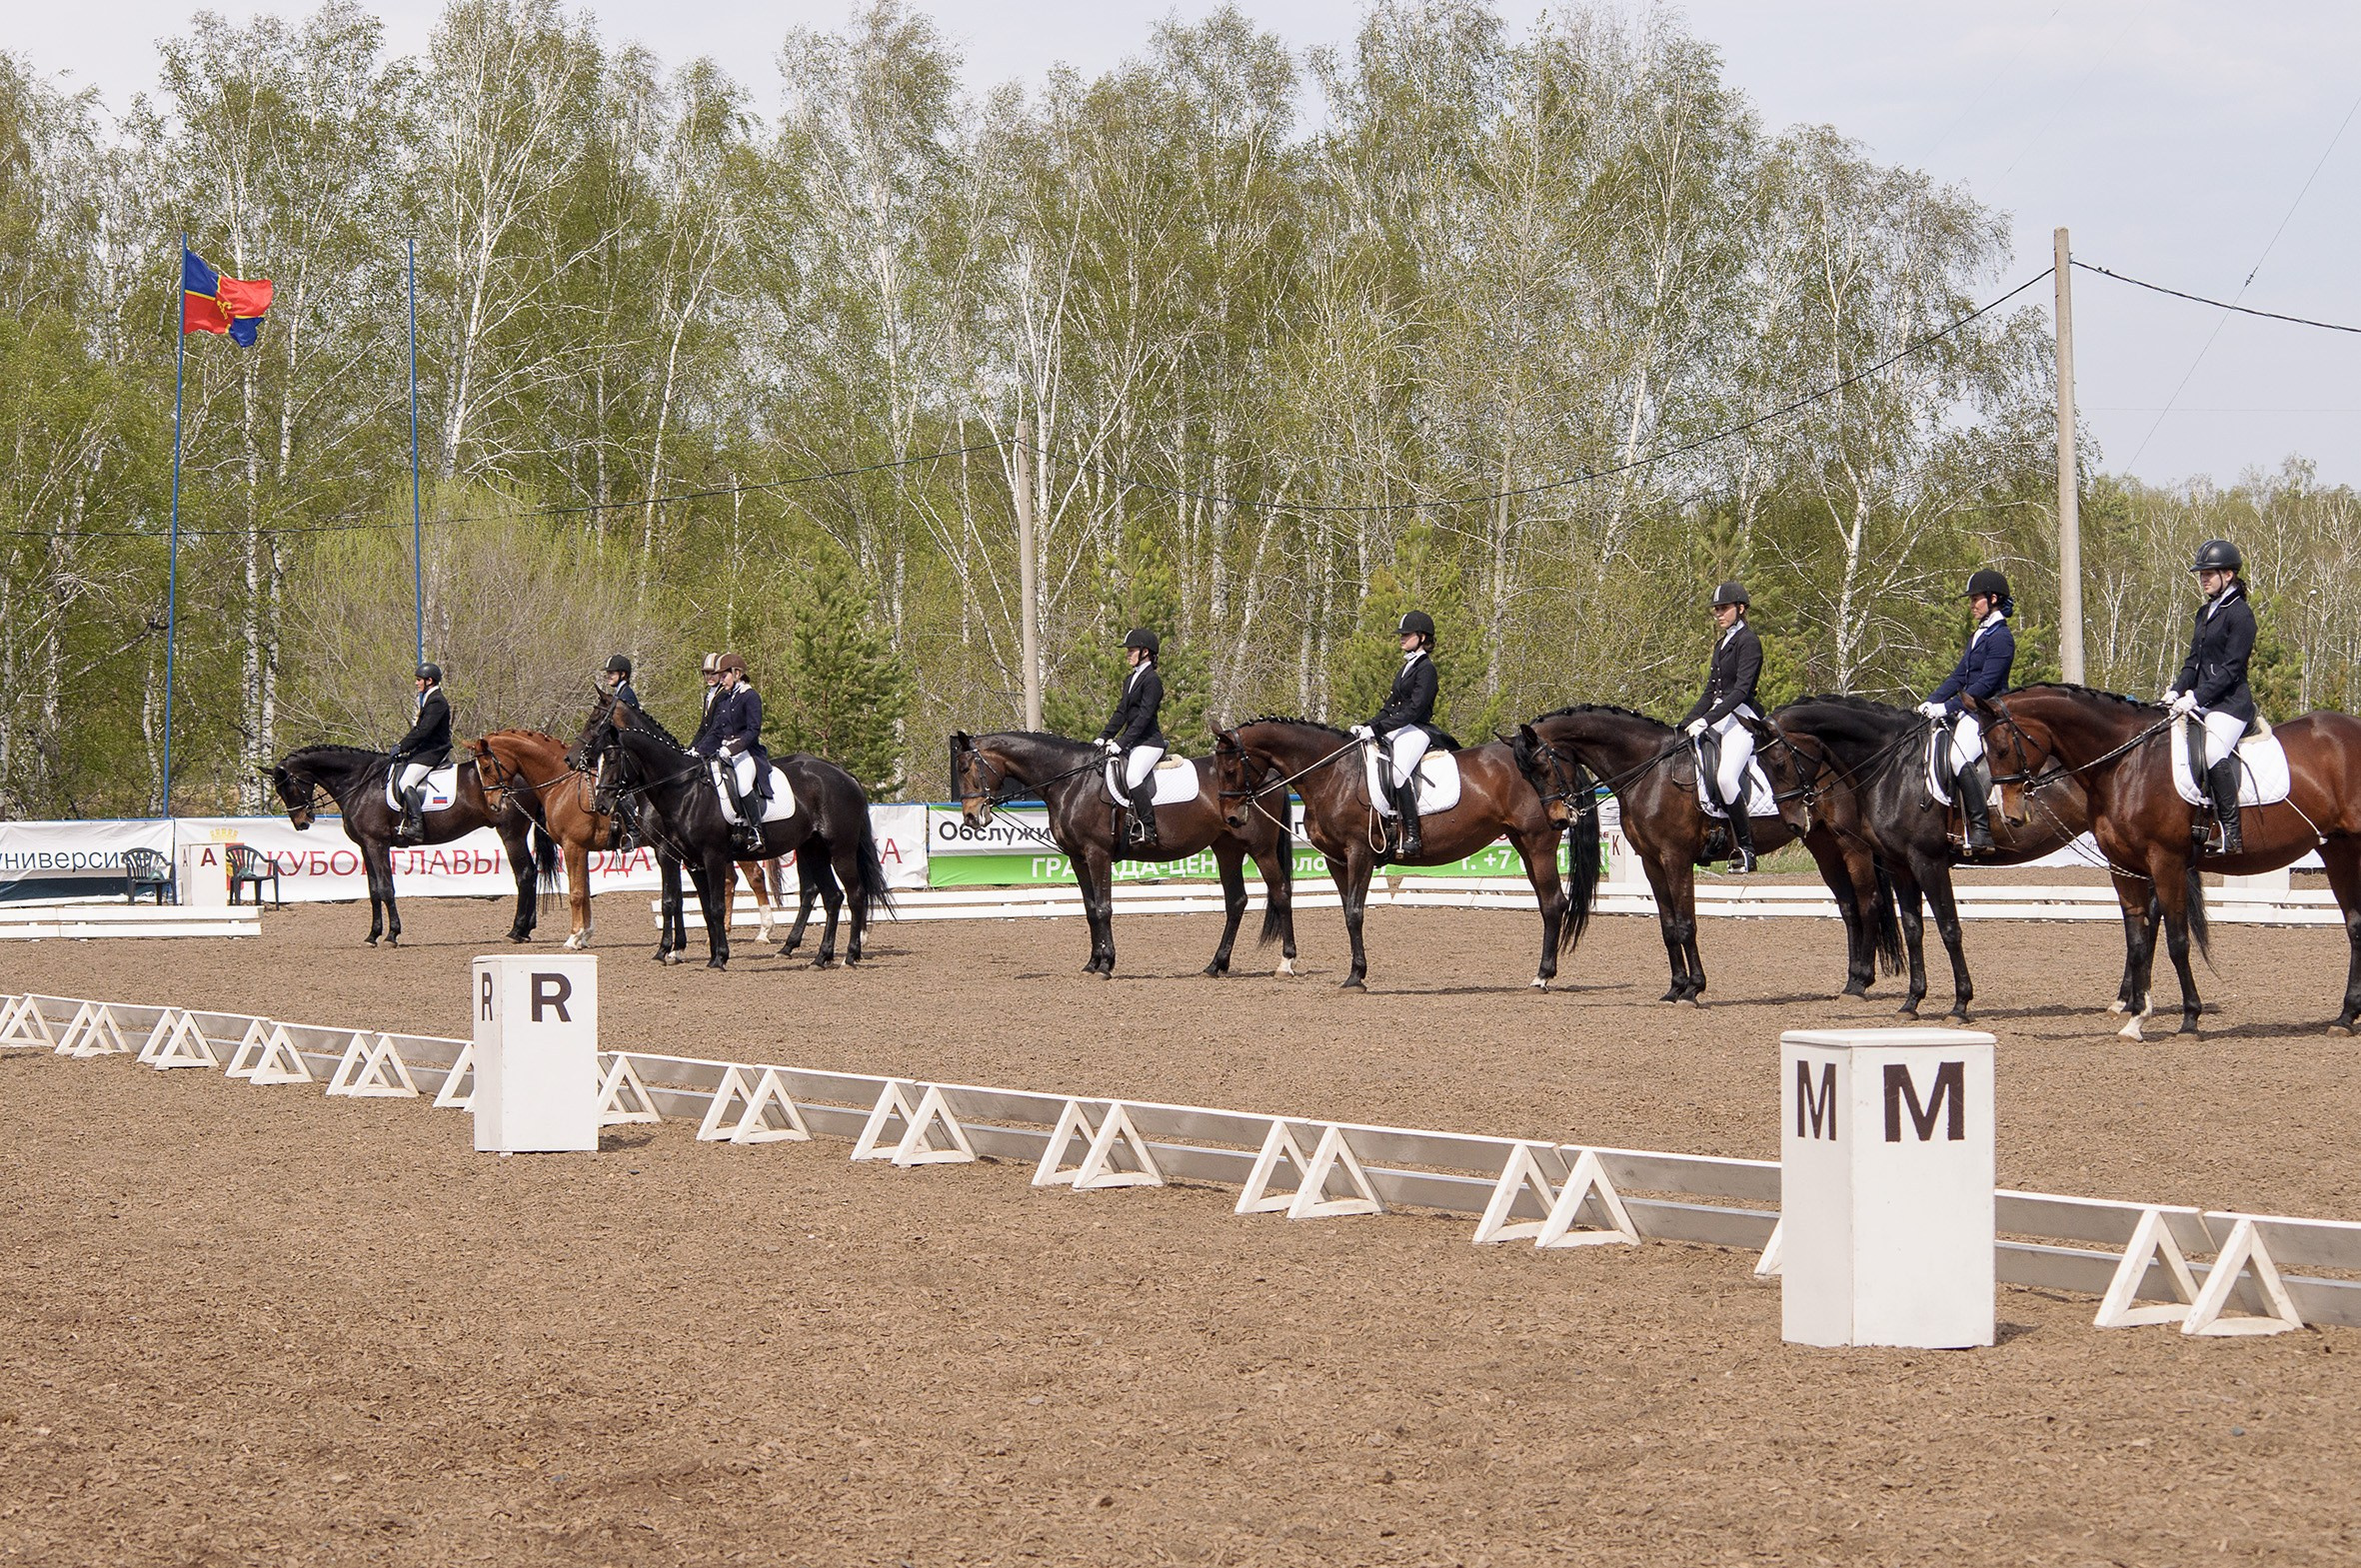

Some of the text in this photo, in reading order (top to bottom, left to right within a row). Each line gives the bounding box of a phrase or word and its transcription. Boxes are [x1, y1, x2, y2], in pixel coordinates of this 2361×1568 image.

[200, 847, 218, 866] A
[266, 850, 370, 876] КУБО
[389, 849, 501, 875] ГЛАВЫ
[482, 972, 493, 1021] R
[531, 972, 572, 1022] R
[1797, 1059, 1836, 1141] M
[1883, 1061, 1965, 1142] M
